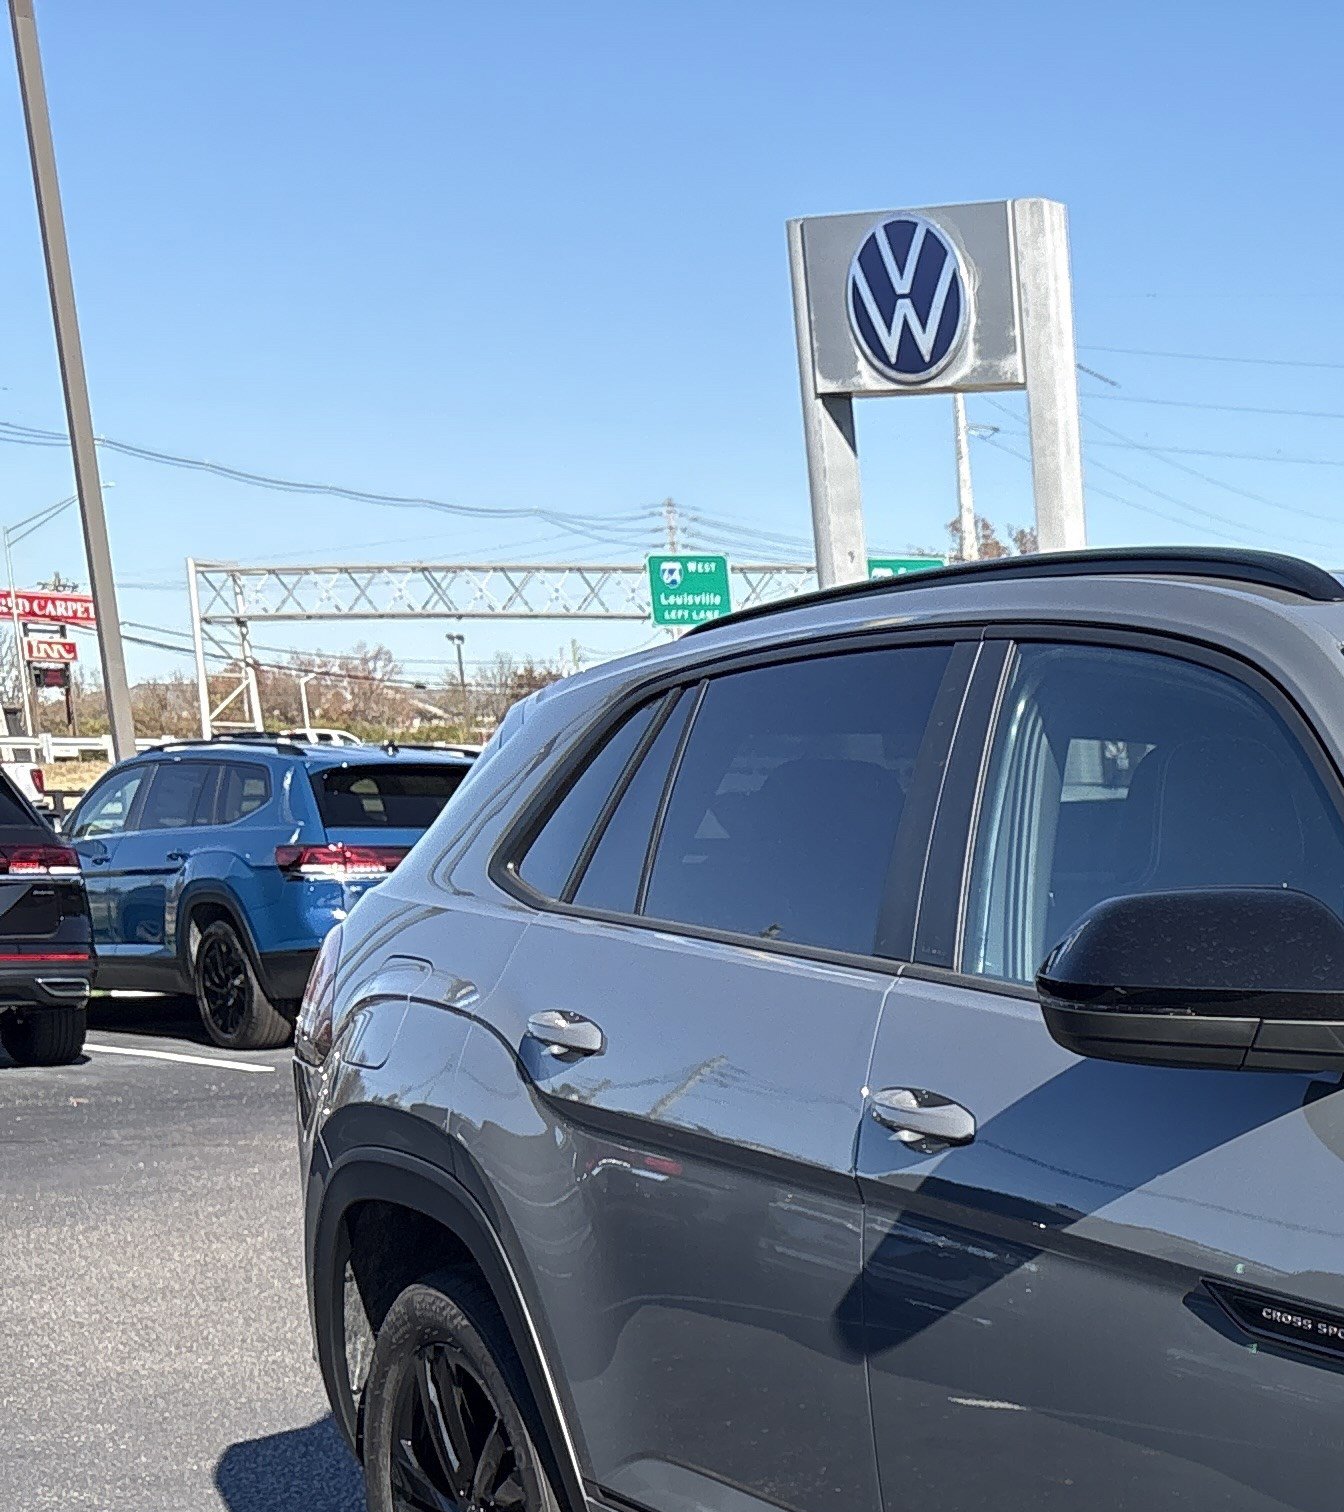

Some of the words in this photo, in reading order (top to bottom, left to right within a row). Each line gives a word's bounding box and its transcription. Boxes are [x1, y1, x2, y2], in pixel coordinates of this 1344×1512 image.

[686, 561, 717, 573] WEST
[660, 592, 721, 606] Louisville
[1261, 1307, 1313, 1330] CROSS
